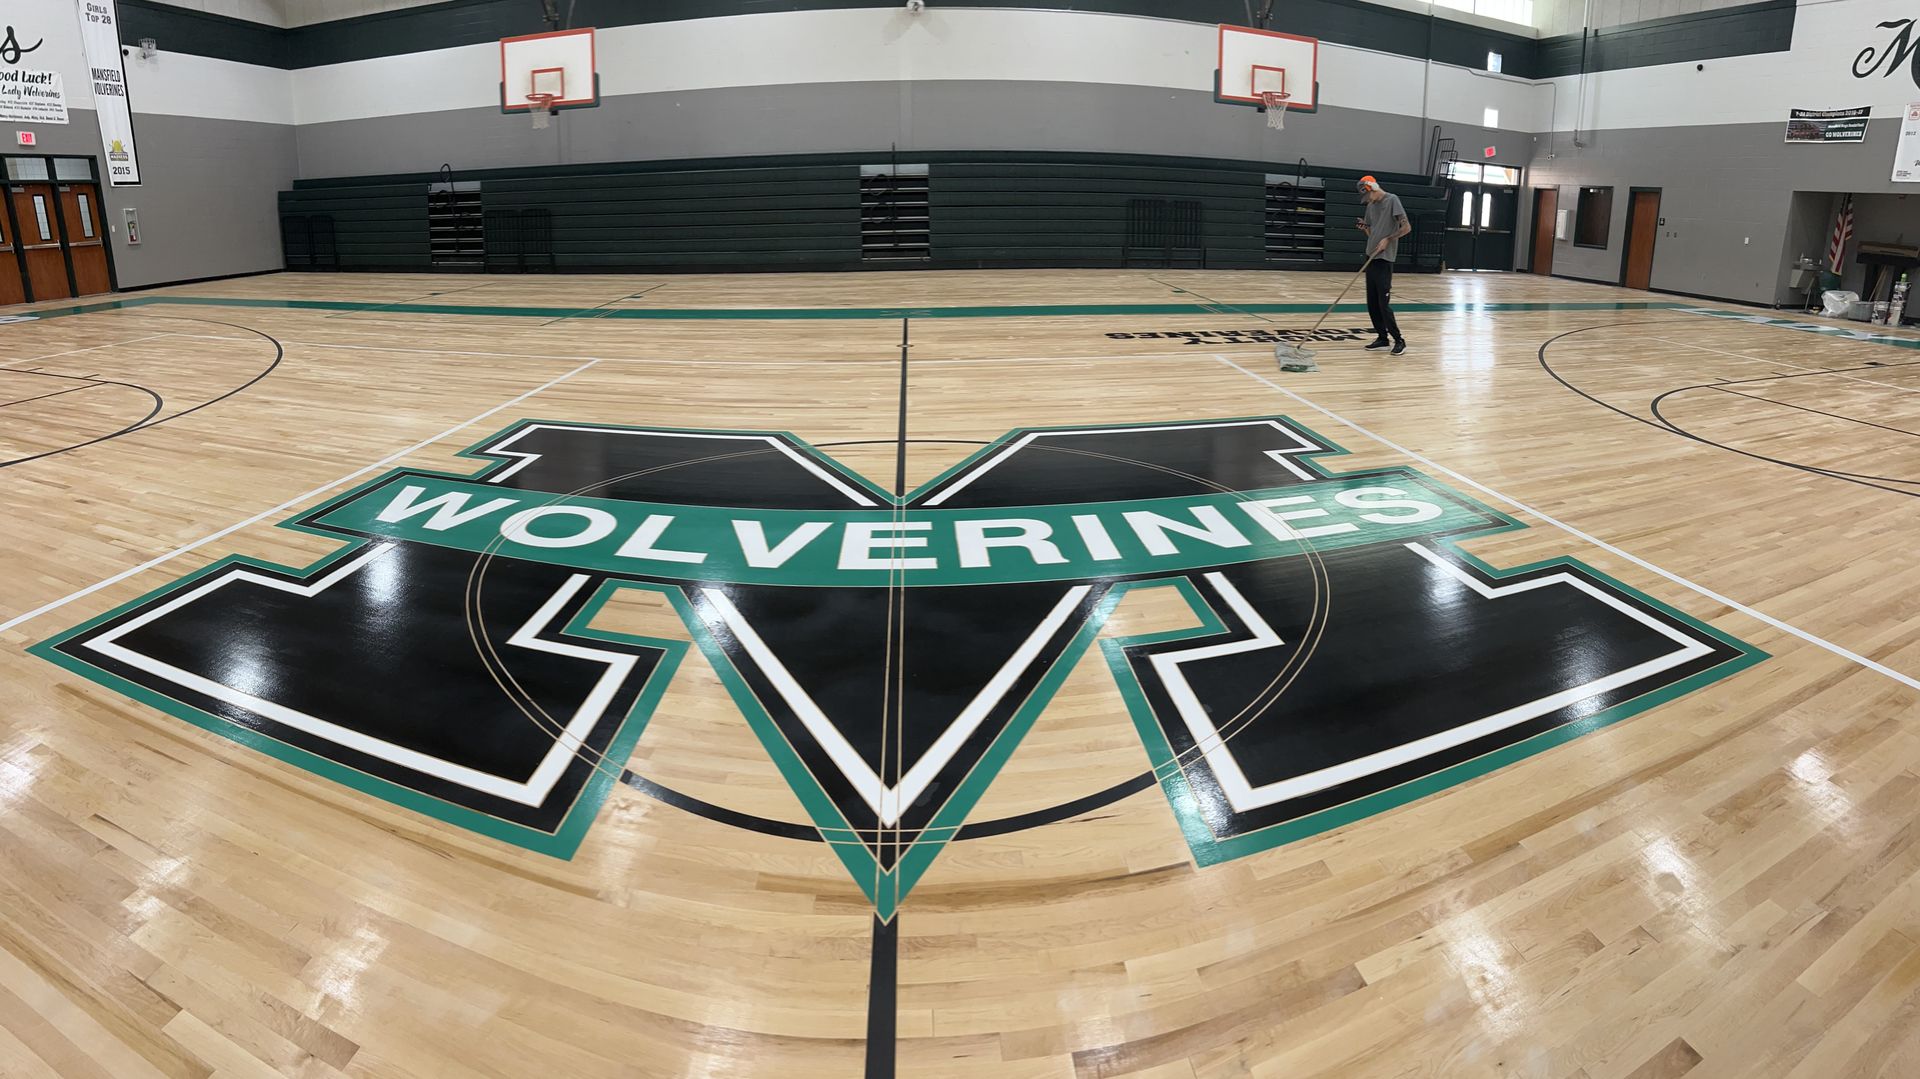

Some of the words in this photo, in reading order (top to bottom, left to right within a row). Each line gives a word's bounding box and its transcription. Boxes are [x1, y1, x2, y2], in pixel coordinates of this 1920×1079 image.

[86, 2, 108, 14] GIRLS
[85, 12, 100, 22] TOP
[101, 15, 112, 24] 28
[22, 70, 52, 85] Luck!
[91, 67, 121, 82] MANSFIELD
[2, 84, 21, 100] Lady
[23, 85, 61, 99] Wolverines
[112, 166, 131, 175] 2015
[376, 485, 1443, 570] WOLVERINES
